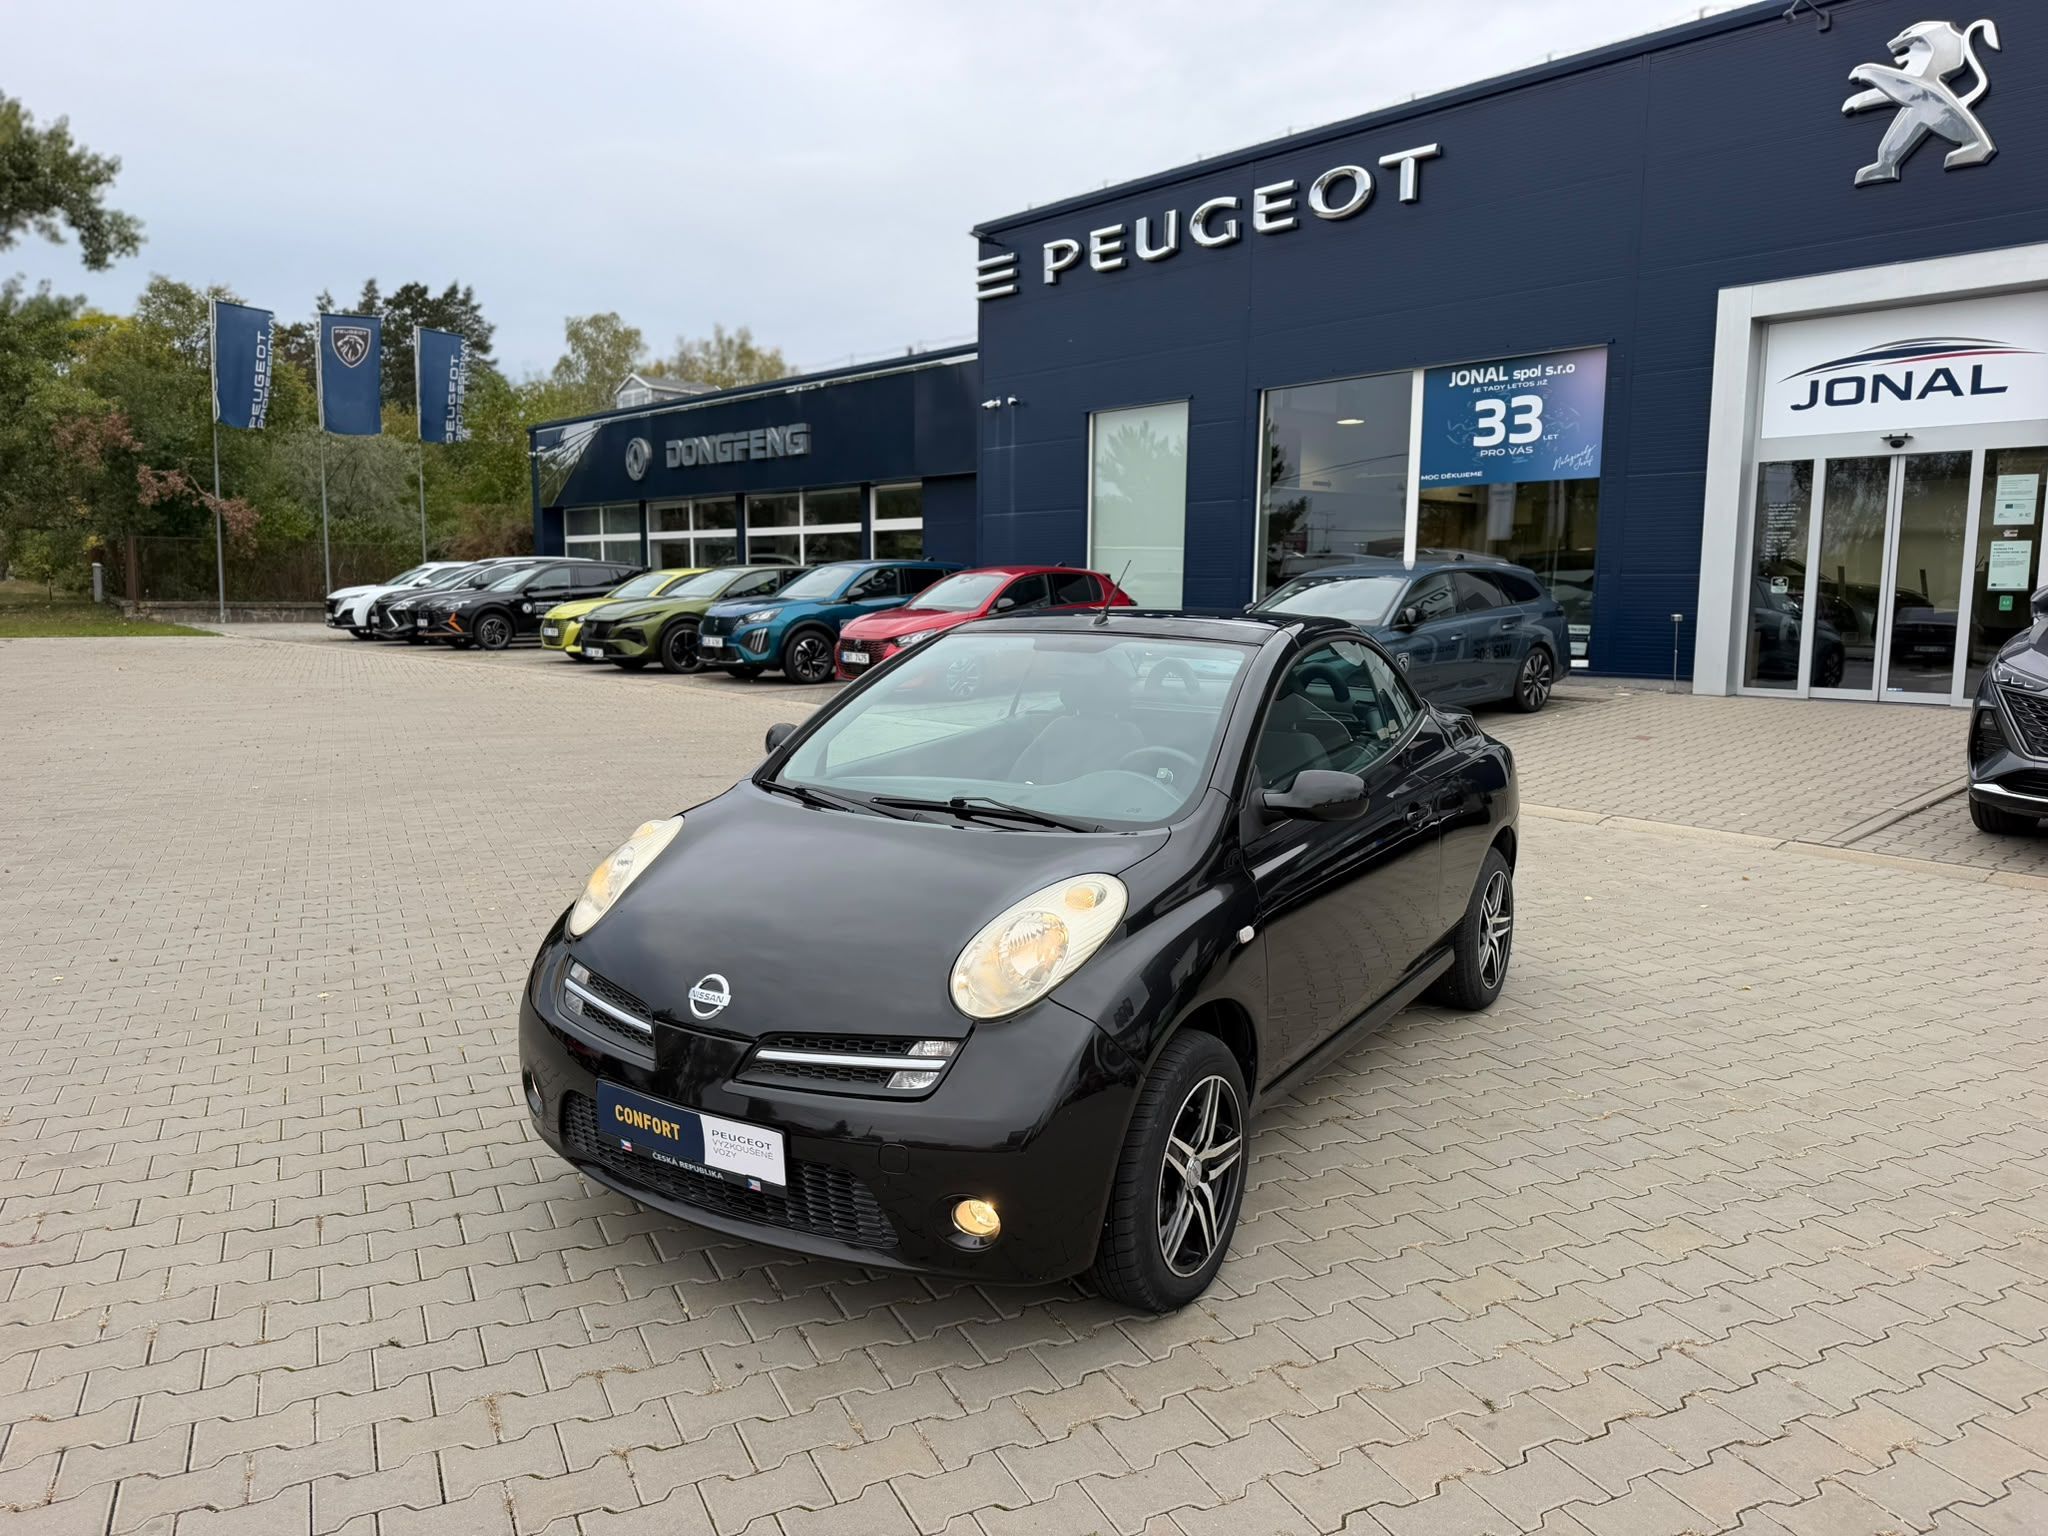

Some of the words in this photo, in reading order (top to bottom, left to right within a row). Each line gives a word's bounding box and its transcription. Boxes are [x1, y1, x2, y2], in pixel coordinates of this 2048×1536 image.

[1043, 142, 1441, 284] PEUGEOT
[249, 331, 266, 429] PEUGEOT
[1448, 366, 1509, 388] JONAL
[1513, 364, 1541, 381] spol
[1545, 363, 1576, 376] s.r.o
[1484, 384, 1505, 392] TADY
[1507, 381, 1535, 389] LETOS
[1790, 364, 2008, 411] JONAL
[1473, 394, 1543, 447] 33
[665, 422, 812, 468] DONGFENG
[1543, 433, 1559, 441] LET
[1480, 449, 1505, 457] PRO
[1509, 446, 1533, 455] VÁS
[1441, 471, 1483, 480] DĚKUJEME
[692, 990, 725, 1003] NISSAN
[615, 1104, 680, 1141] CONFORT
[711, 1129, 772, 1150] PEUGEOT
[712, 1138, 774, 1161] VYZKOUŠENÉ
[713, 1147, 737, 1159] VOZY
[652, 1151, 679, 1167] ČESKÁ
[679, 1160, 724, 1180] REPUBLIKA
